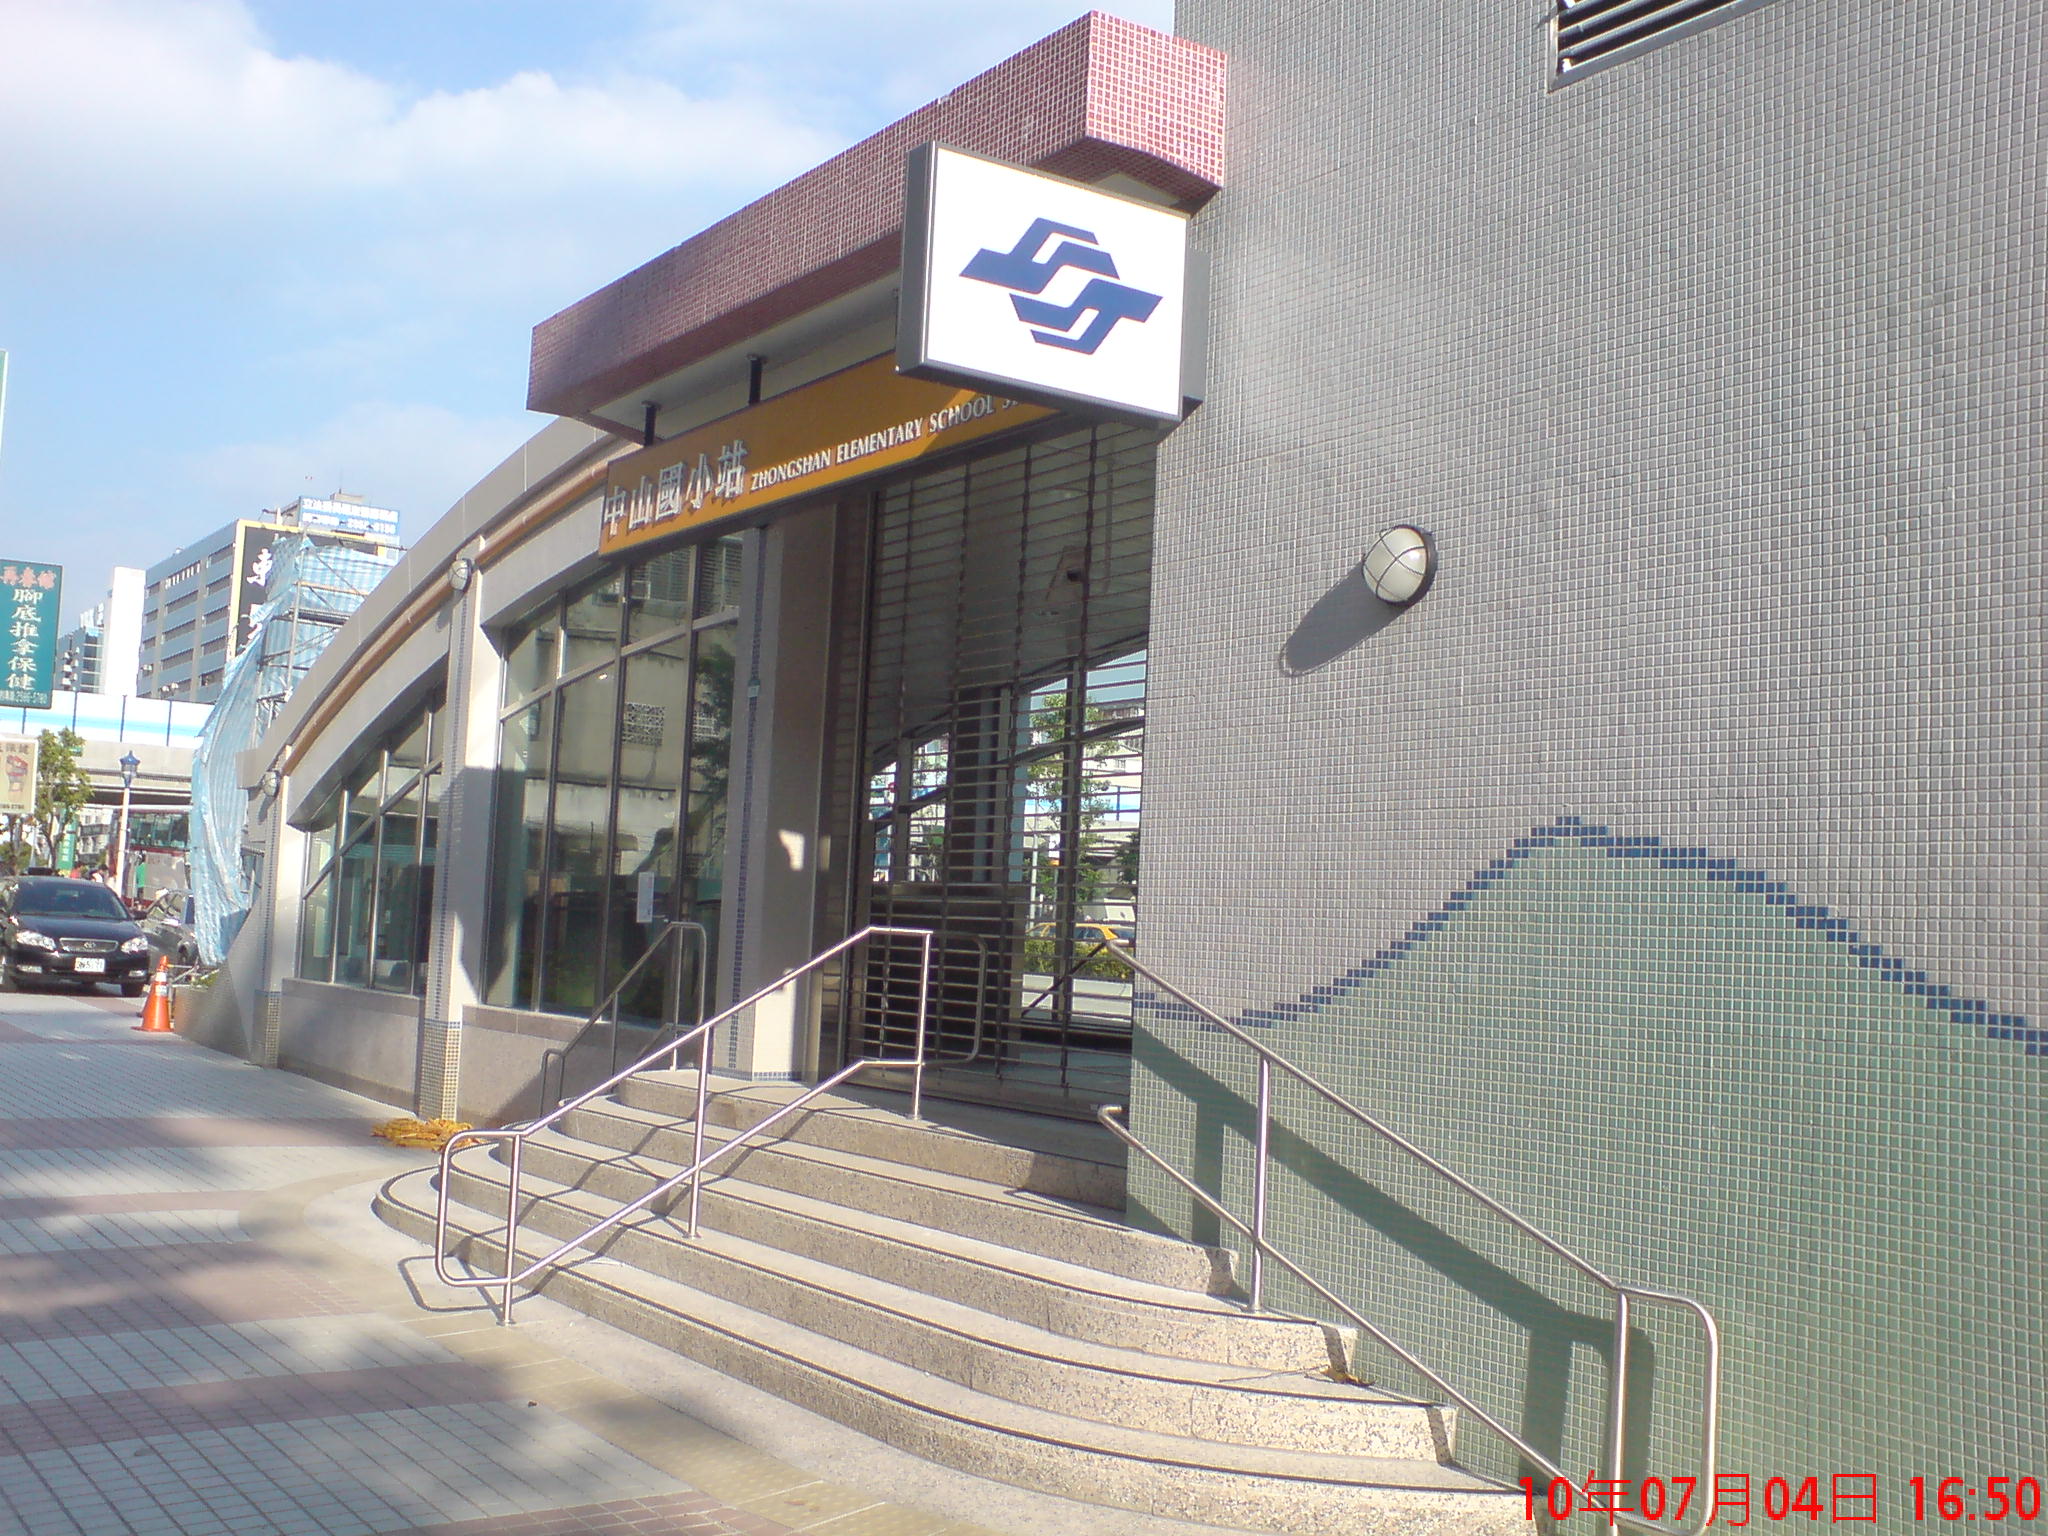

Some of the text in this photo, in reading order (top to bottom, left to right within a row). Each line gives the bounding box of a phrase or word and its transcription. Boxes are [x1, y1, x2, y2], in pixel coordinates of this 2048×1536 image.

[603, 440, 749, 536] 中山國小站
[751, 395, 996, 491] ZHONGSHAN ELEMENTARY SCHOOL
[7, 588, 44, 691] 腳底推拿保健
